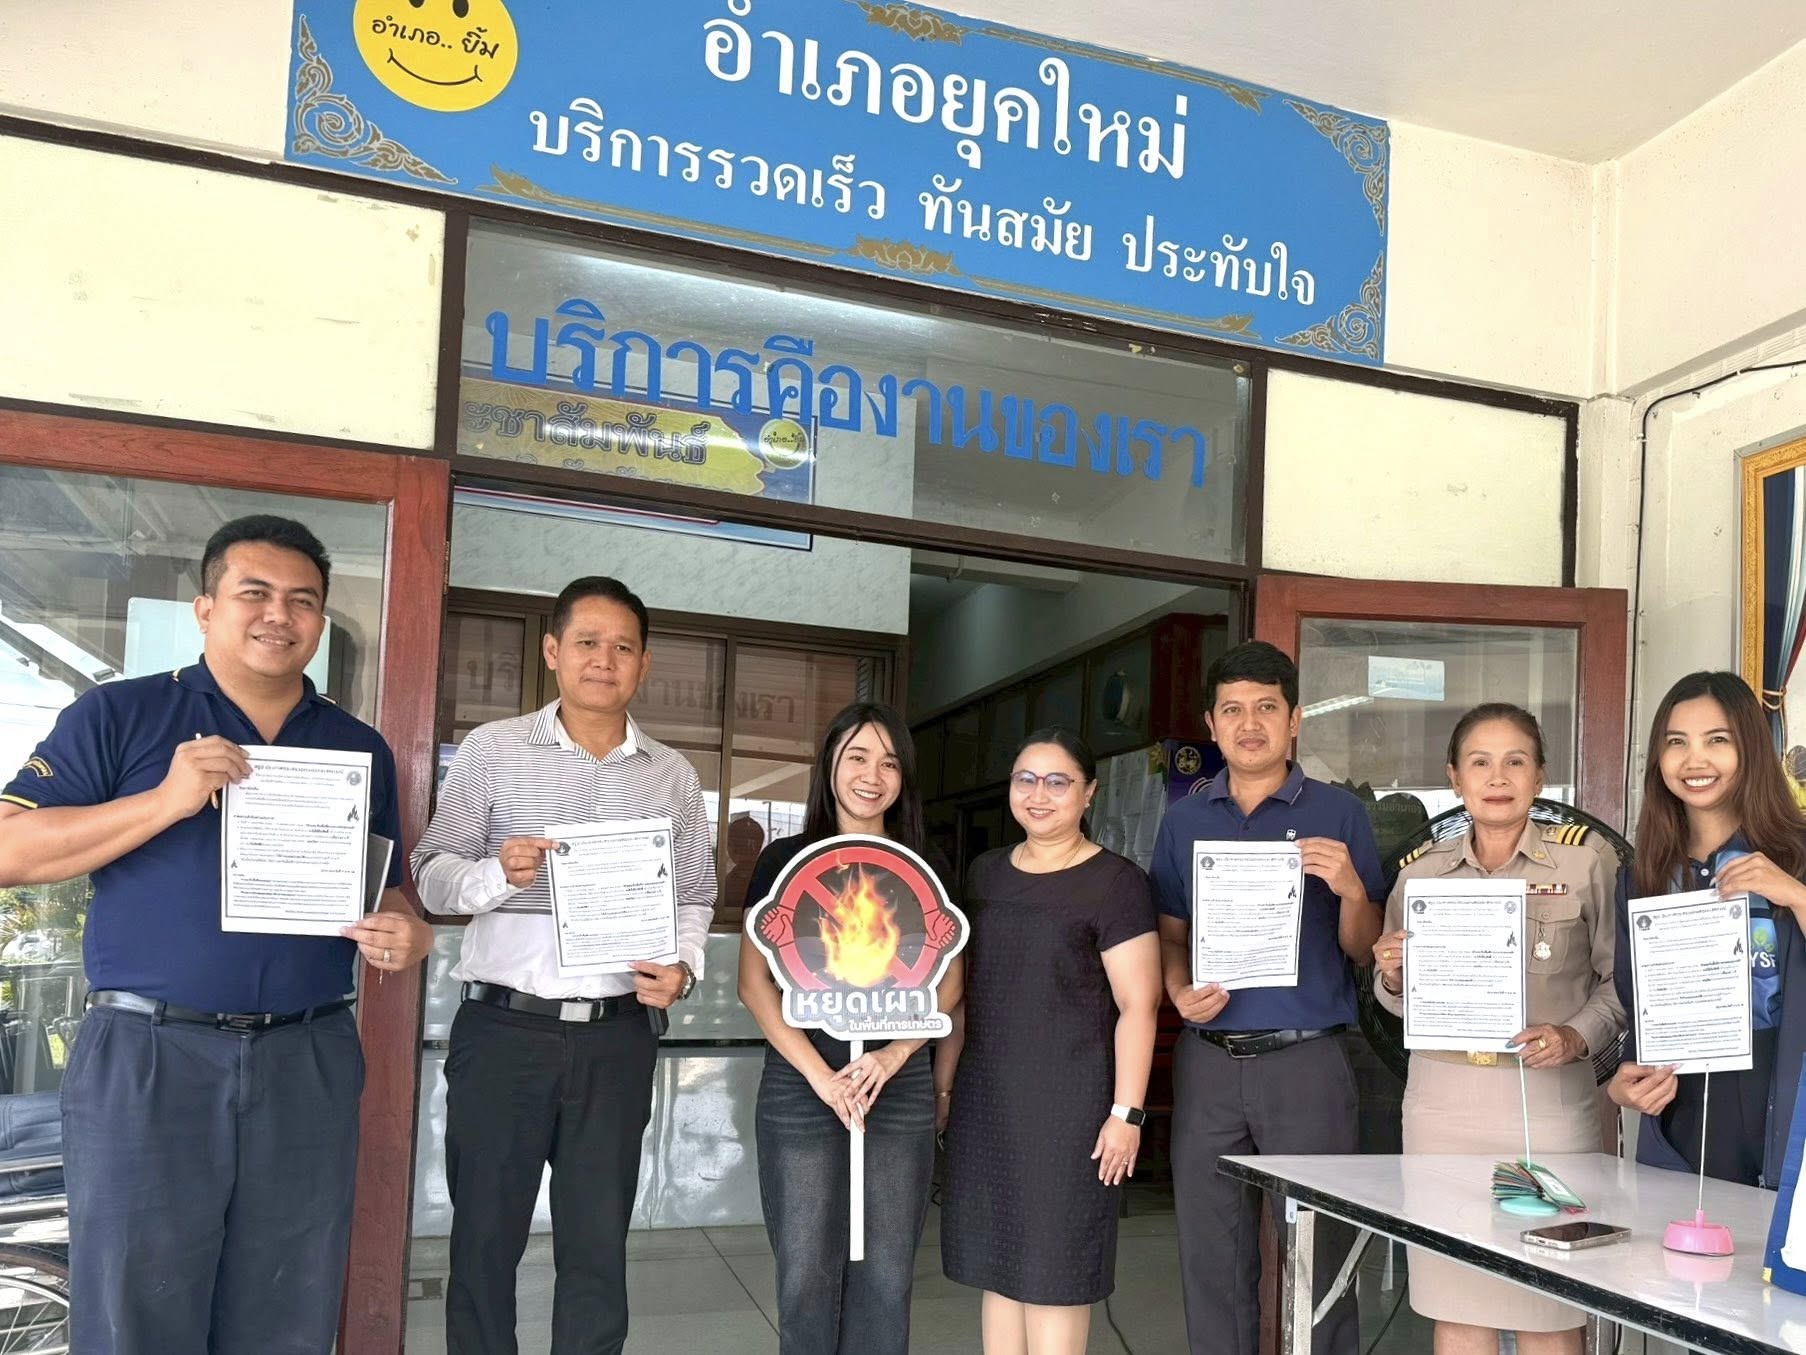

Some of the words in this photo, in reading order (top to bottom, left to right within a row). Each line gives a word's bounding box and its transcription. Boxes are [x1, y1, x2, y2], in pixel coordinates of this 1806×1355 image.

[461, 26, 499, 59] ยิ้ม
[703, 0, 1188, 180] อำเภอยุคใหม่
[529, 97, 887, 220] บริการรวดเร็ว
[918, 174, 1093, 261] ทันสมัย
[1122, 215, 1315, 306] ประทับใจ
[486, 298, 1206, 488] บริการคืองานของเรา
[796, 989, 926, 1024] หยุดเผา
